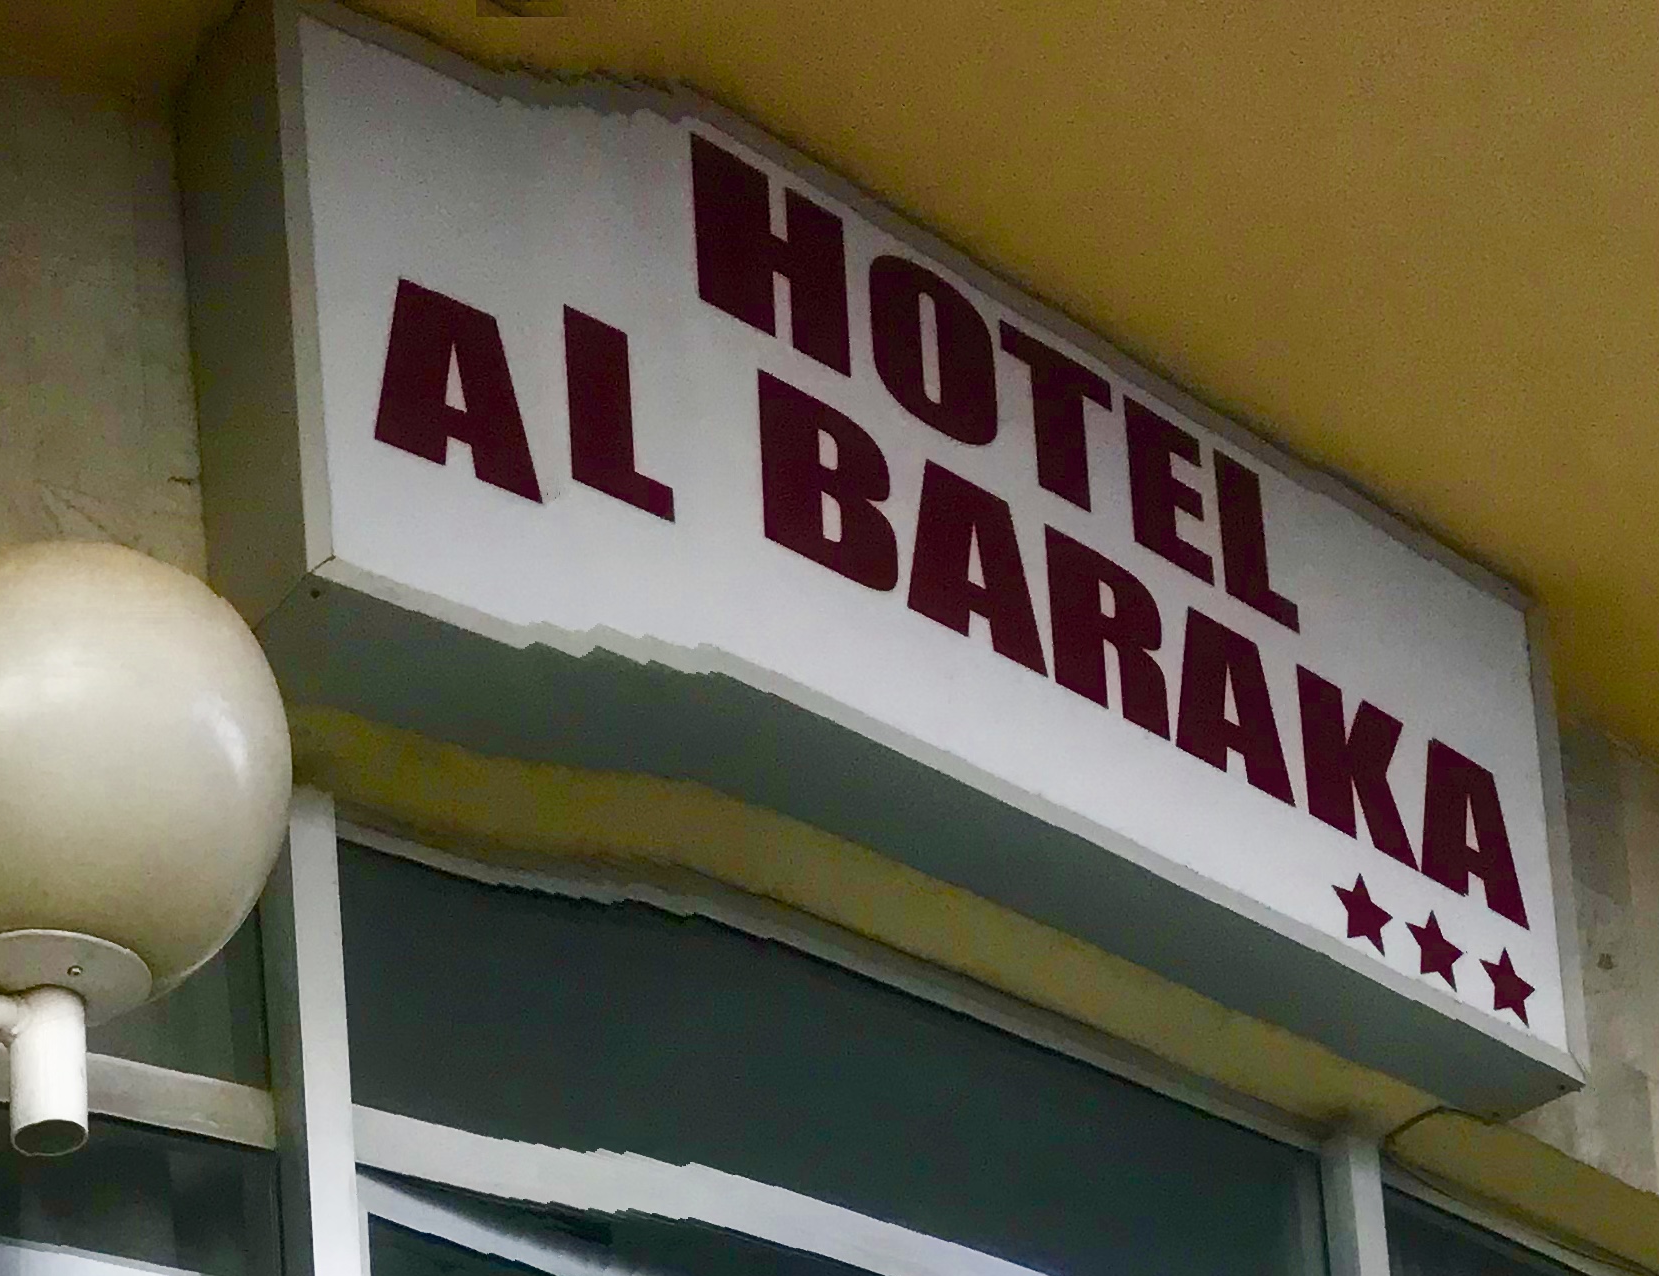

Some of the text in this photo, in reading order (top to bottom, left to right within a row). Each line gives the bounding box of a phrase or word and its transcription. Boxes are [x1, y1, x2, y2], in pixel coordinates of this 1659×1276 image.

[373, 277, 1531, 931] AL BARAKA
[689, 131, 1301, 634] HOTEL
